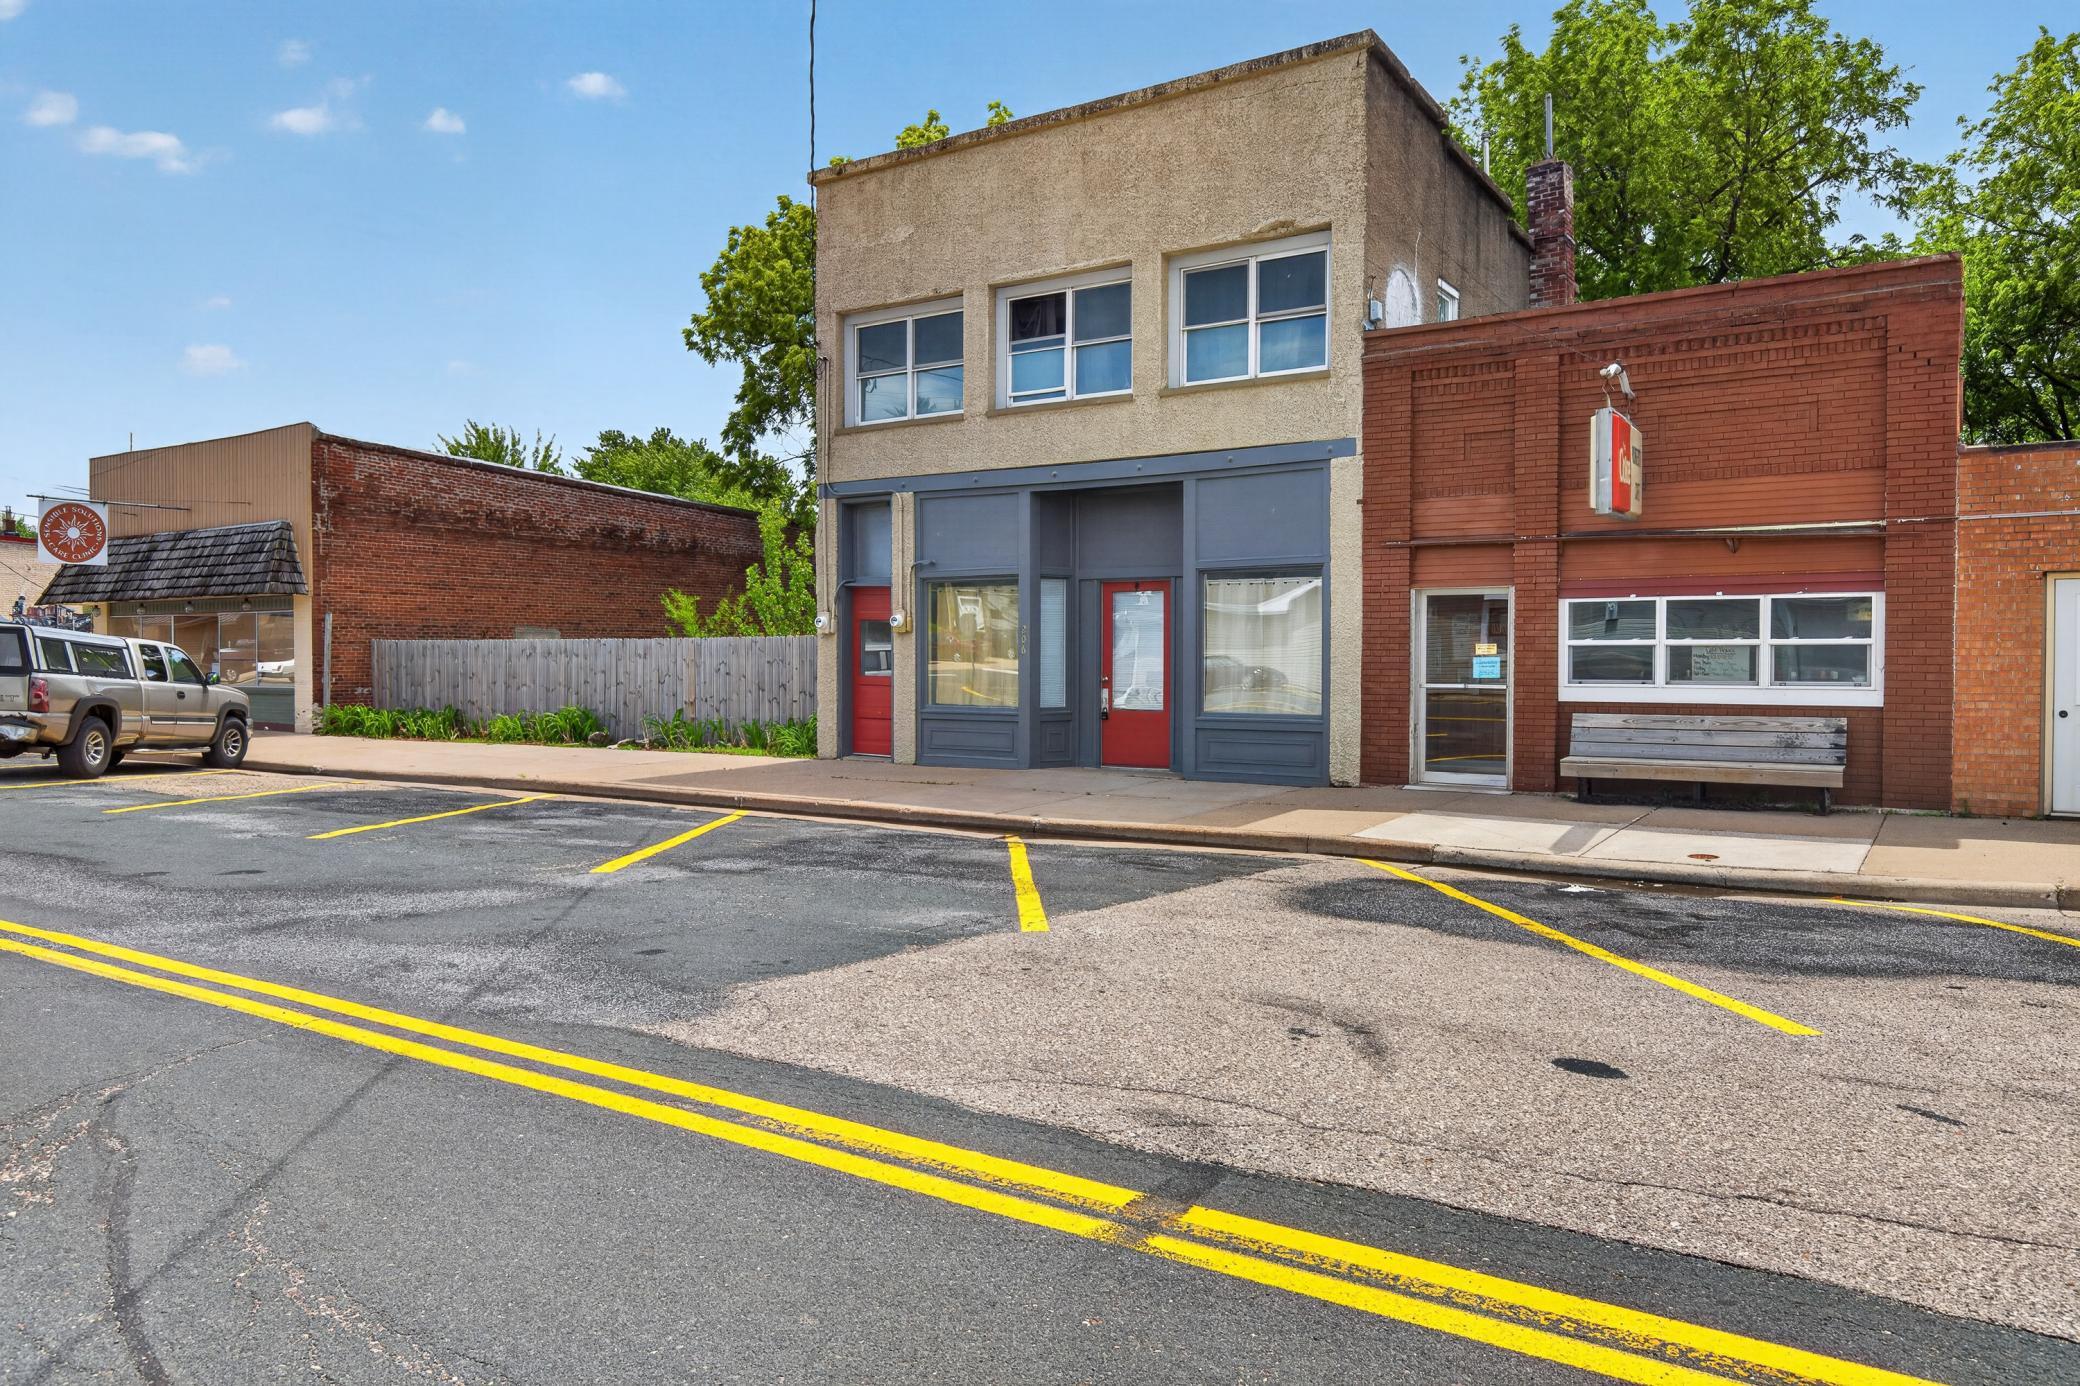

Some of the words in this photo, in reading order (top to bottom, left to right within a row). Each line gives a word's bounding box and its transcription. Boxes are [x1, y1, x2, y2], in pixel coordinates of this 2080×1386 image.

[44, 507, 69, 538] SENSIBLE
[72, 506, 102, 542] SOLUTIONS
[48, 542, 68, 559] CARE
[72, 546, 98, 560] CLINIC
